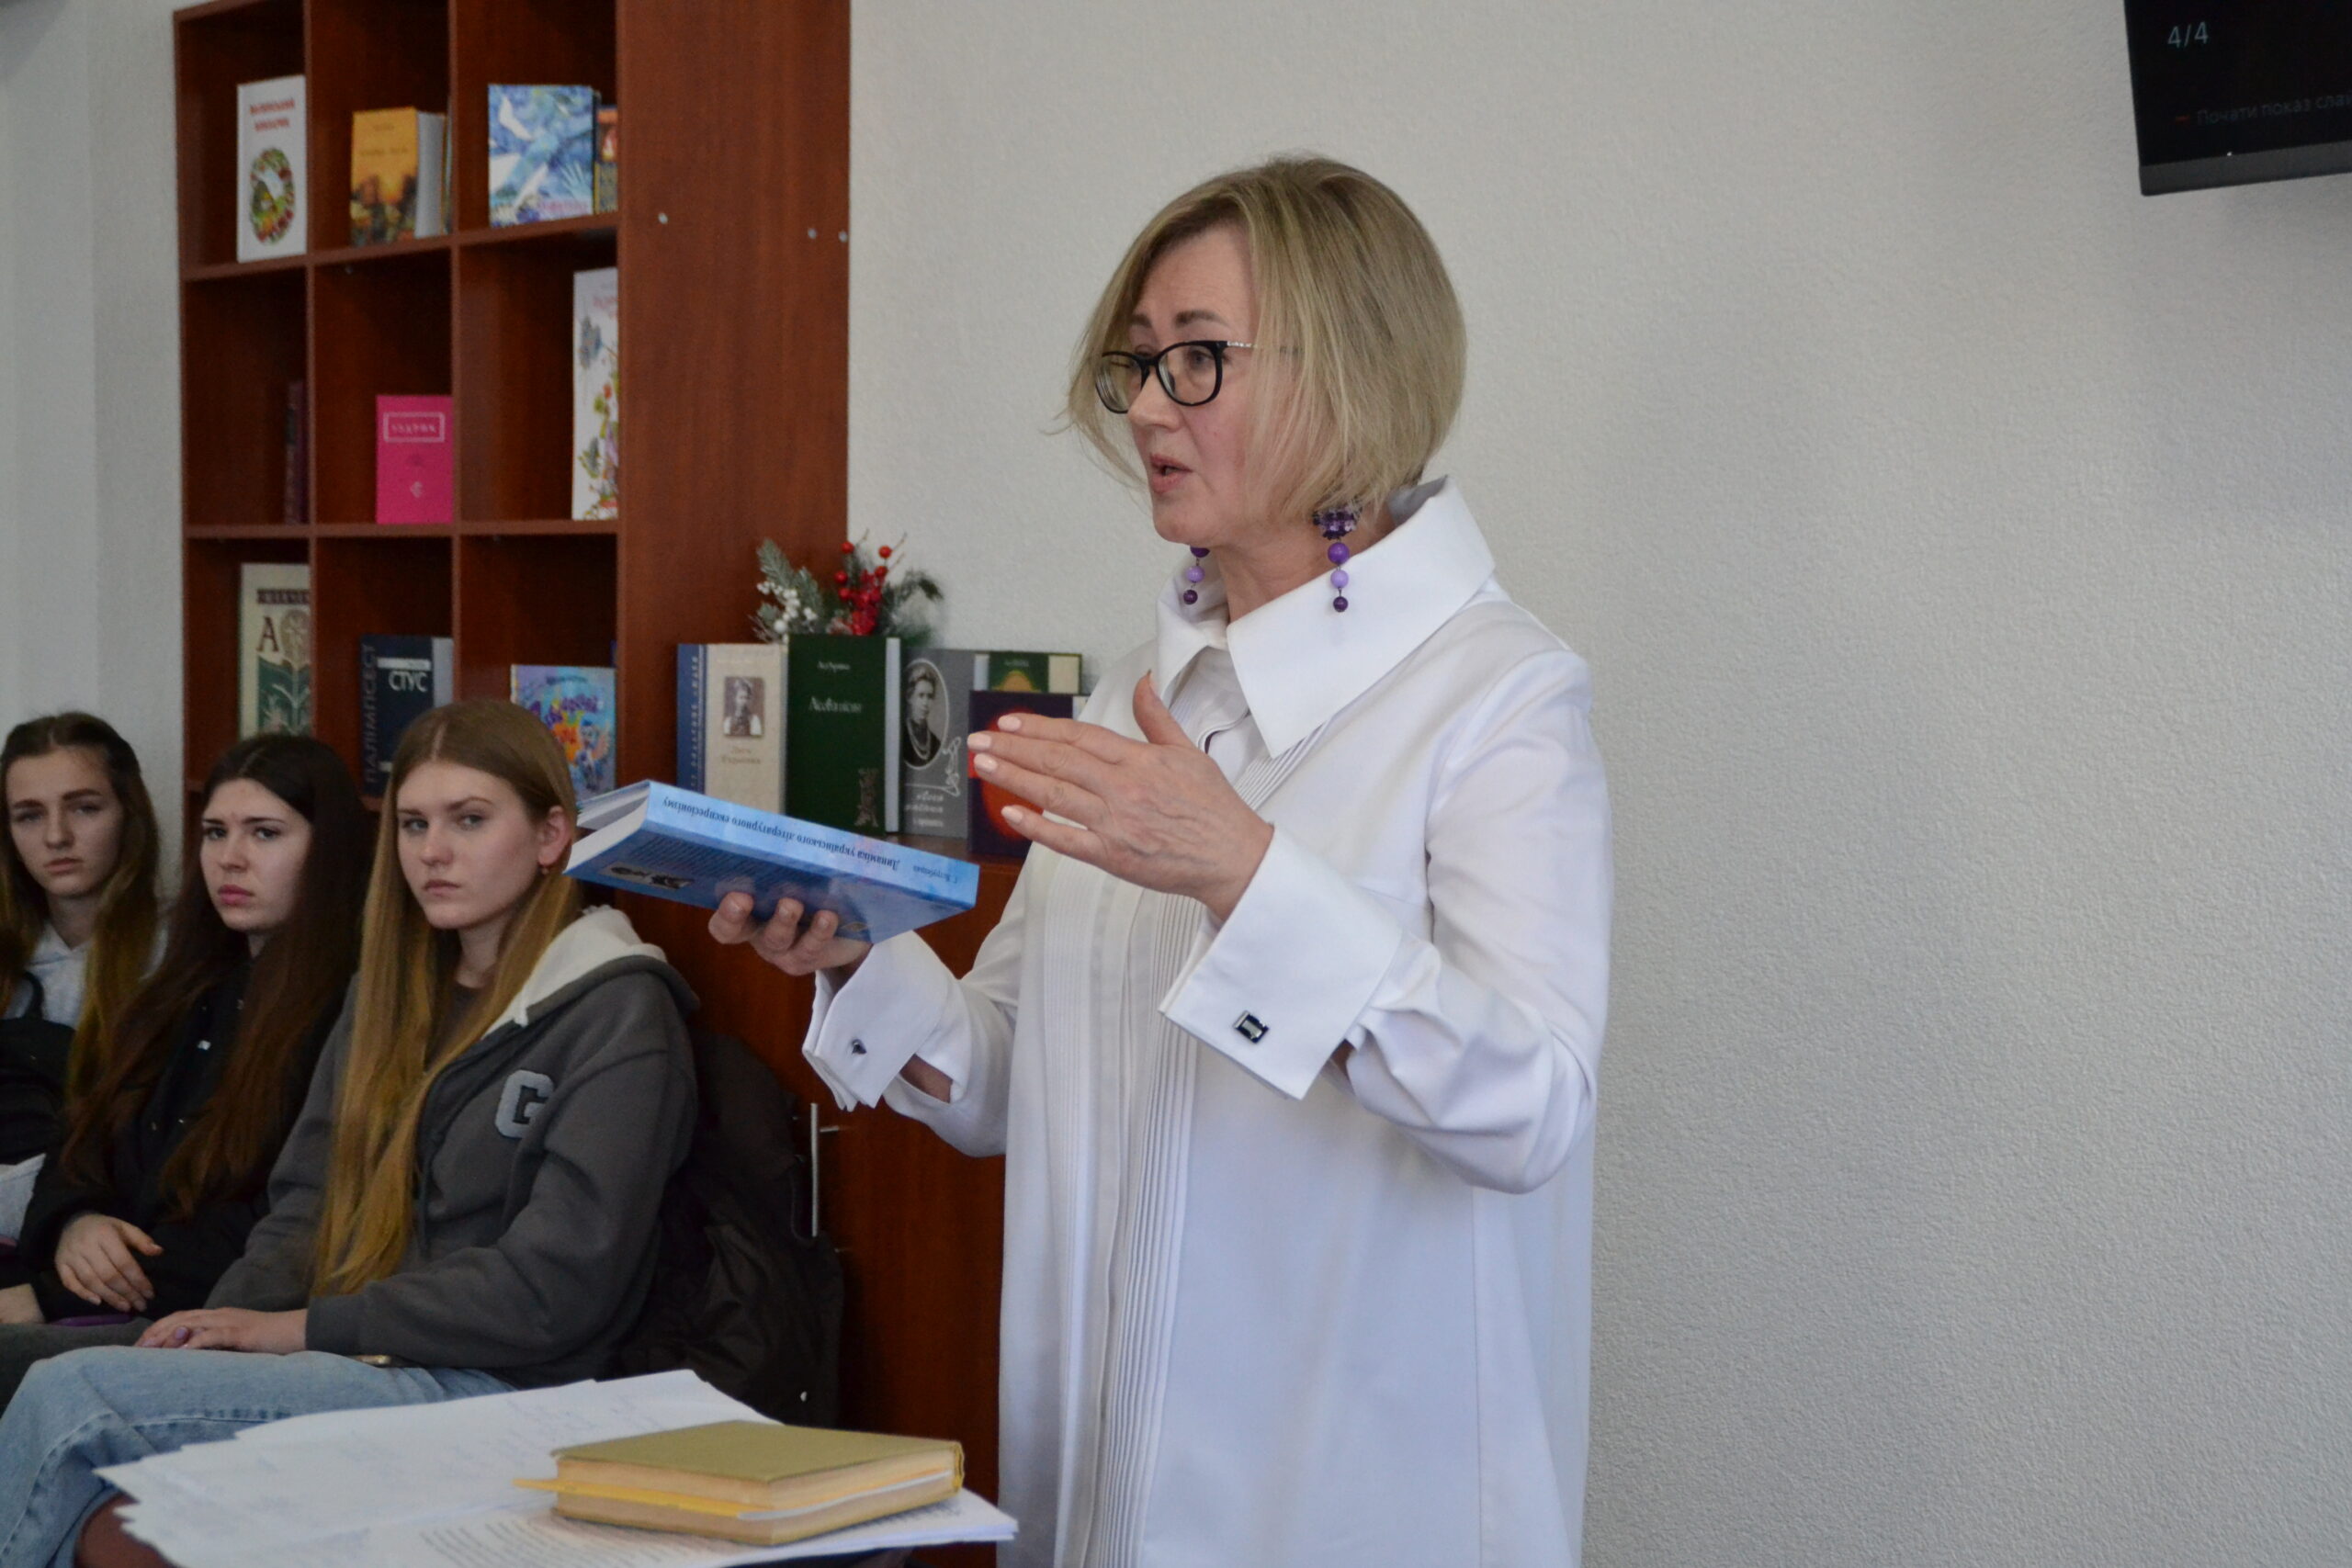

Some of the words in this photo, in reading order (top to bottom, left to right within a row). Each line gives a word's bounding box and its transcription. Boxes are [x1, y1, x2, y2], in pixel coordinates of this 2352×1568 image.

[2167, 21, 2210, 48] 4/4
[2197, 104, 2258, 126] Почати
[2260, 97, 2311, 117] показ
[388, 670, 428, 693] СТУС
[662, 796, 730, 826] експресіонізму
[730, 816, 796, 843] літературного
[796, 833, 855, 858] українського
[856, 850, 900, 873] Динаміка
[495, 1071, 553, 1138] G
